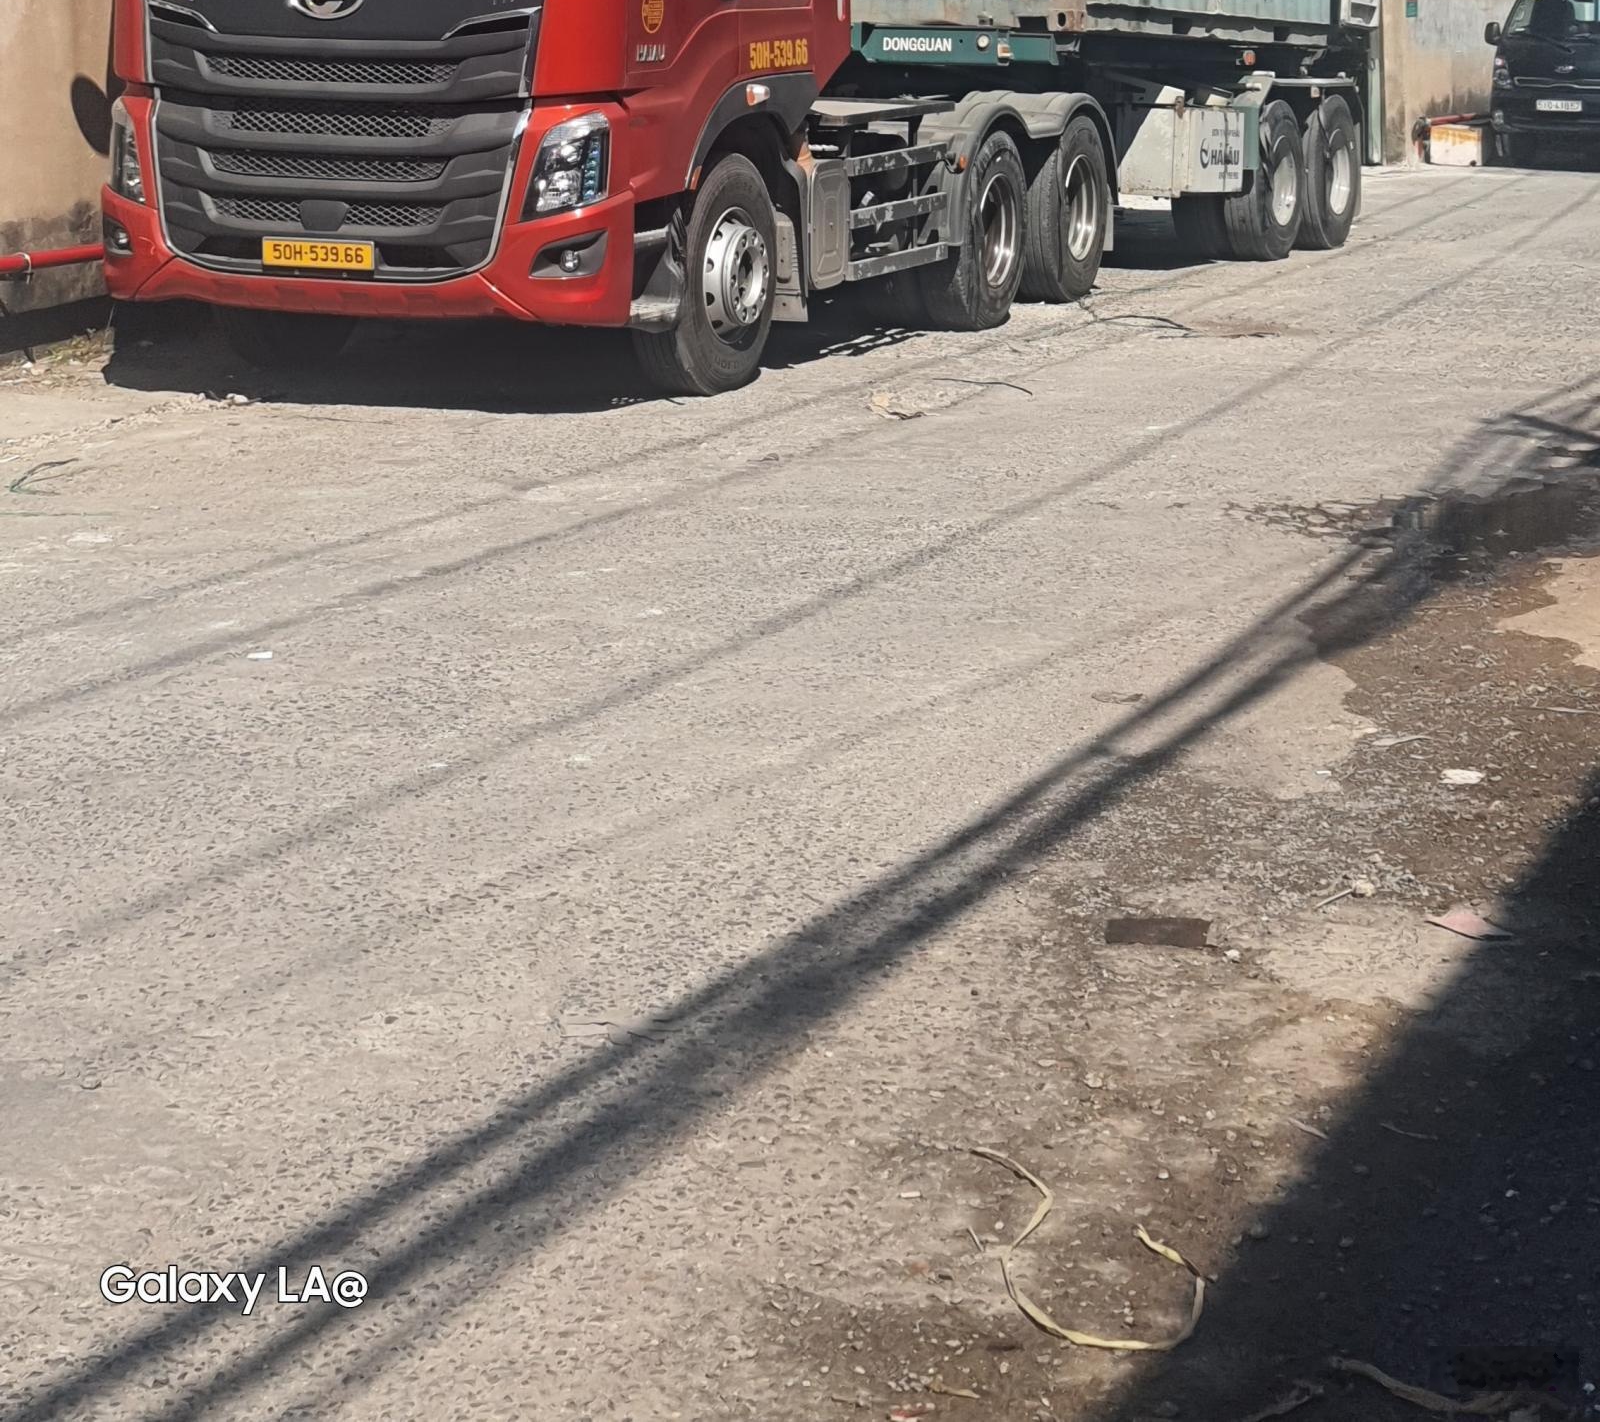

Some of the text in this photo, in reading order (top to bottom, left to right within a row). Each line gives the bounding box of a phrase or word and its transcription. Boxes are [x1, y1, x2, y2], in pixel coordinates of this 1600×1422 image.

[749, 38, 809, 70] 50H-539.66
[883, 37, 952, 52] DONGGUAN
[272, 243, 364, 264] 50H-539.66
